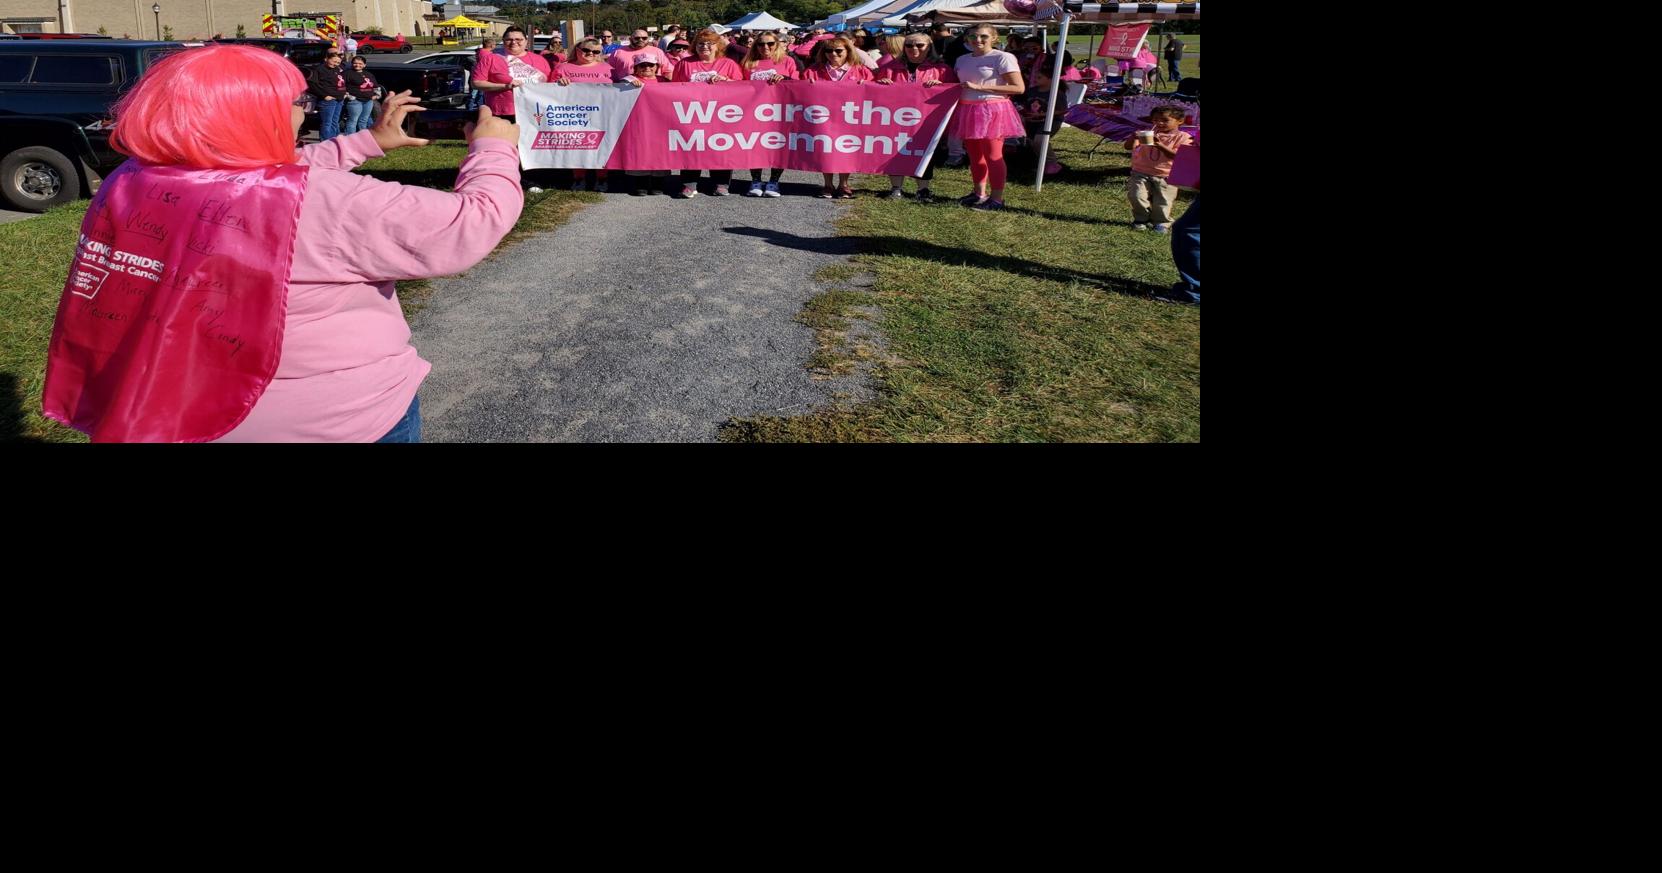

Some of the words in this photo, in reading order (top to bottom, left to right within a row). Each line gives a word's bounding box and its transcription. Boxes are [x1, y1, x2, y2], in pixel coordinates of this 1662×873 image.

[547, 119, 589, 127] Society
[672, 101, 744, 124] We
[754, 103, 830, 123] are
[841, 100, 922, 127] the
[668, 129, 924, 156] Movement.
[146, 182, 181, 208] Lisa
[125, 208, 169, 243] Wendy
[113, 251, 165, 272] STRIDES
